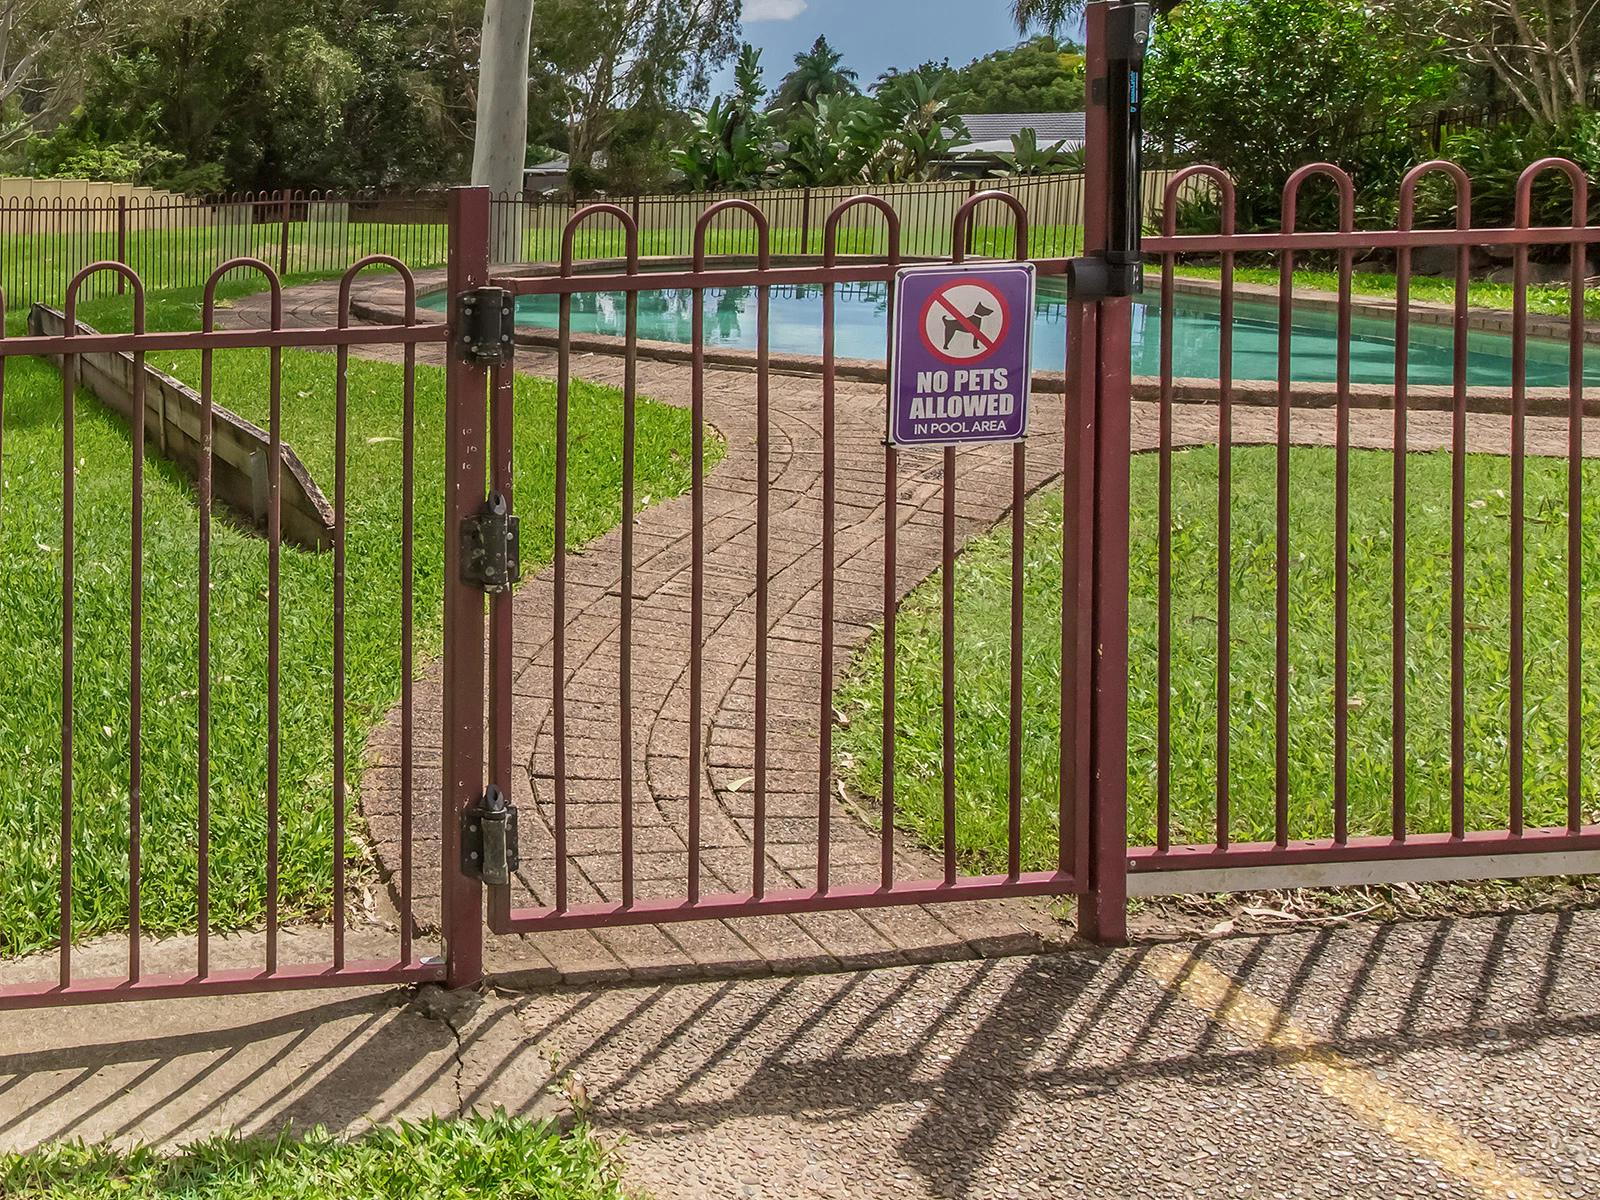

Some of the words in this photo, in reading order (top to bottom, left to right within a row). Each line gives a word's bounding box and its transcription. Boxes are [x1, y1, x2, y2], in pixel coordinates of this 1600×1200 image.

[916, 370, 948, 393] NO
[954, 367, 1008, 392] PETS
[909, 393, 1014, 419] ALLOWED
[914, 423, 928, 434] IN
[930, 421, 969, 434] POOL
[971, 420, 1006, 432] AREA
